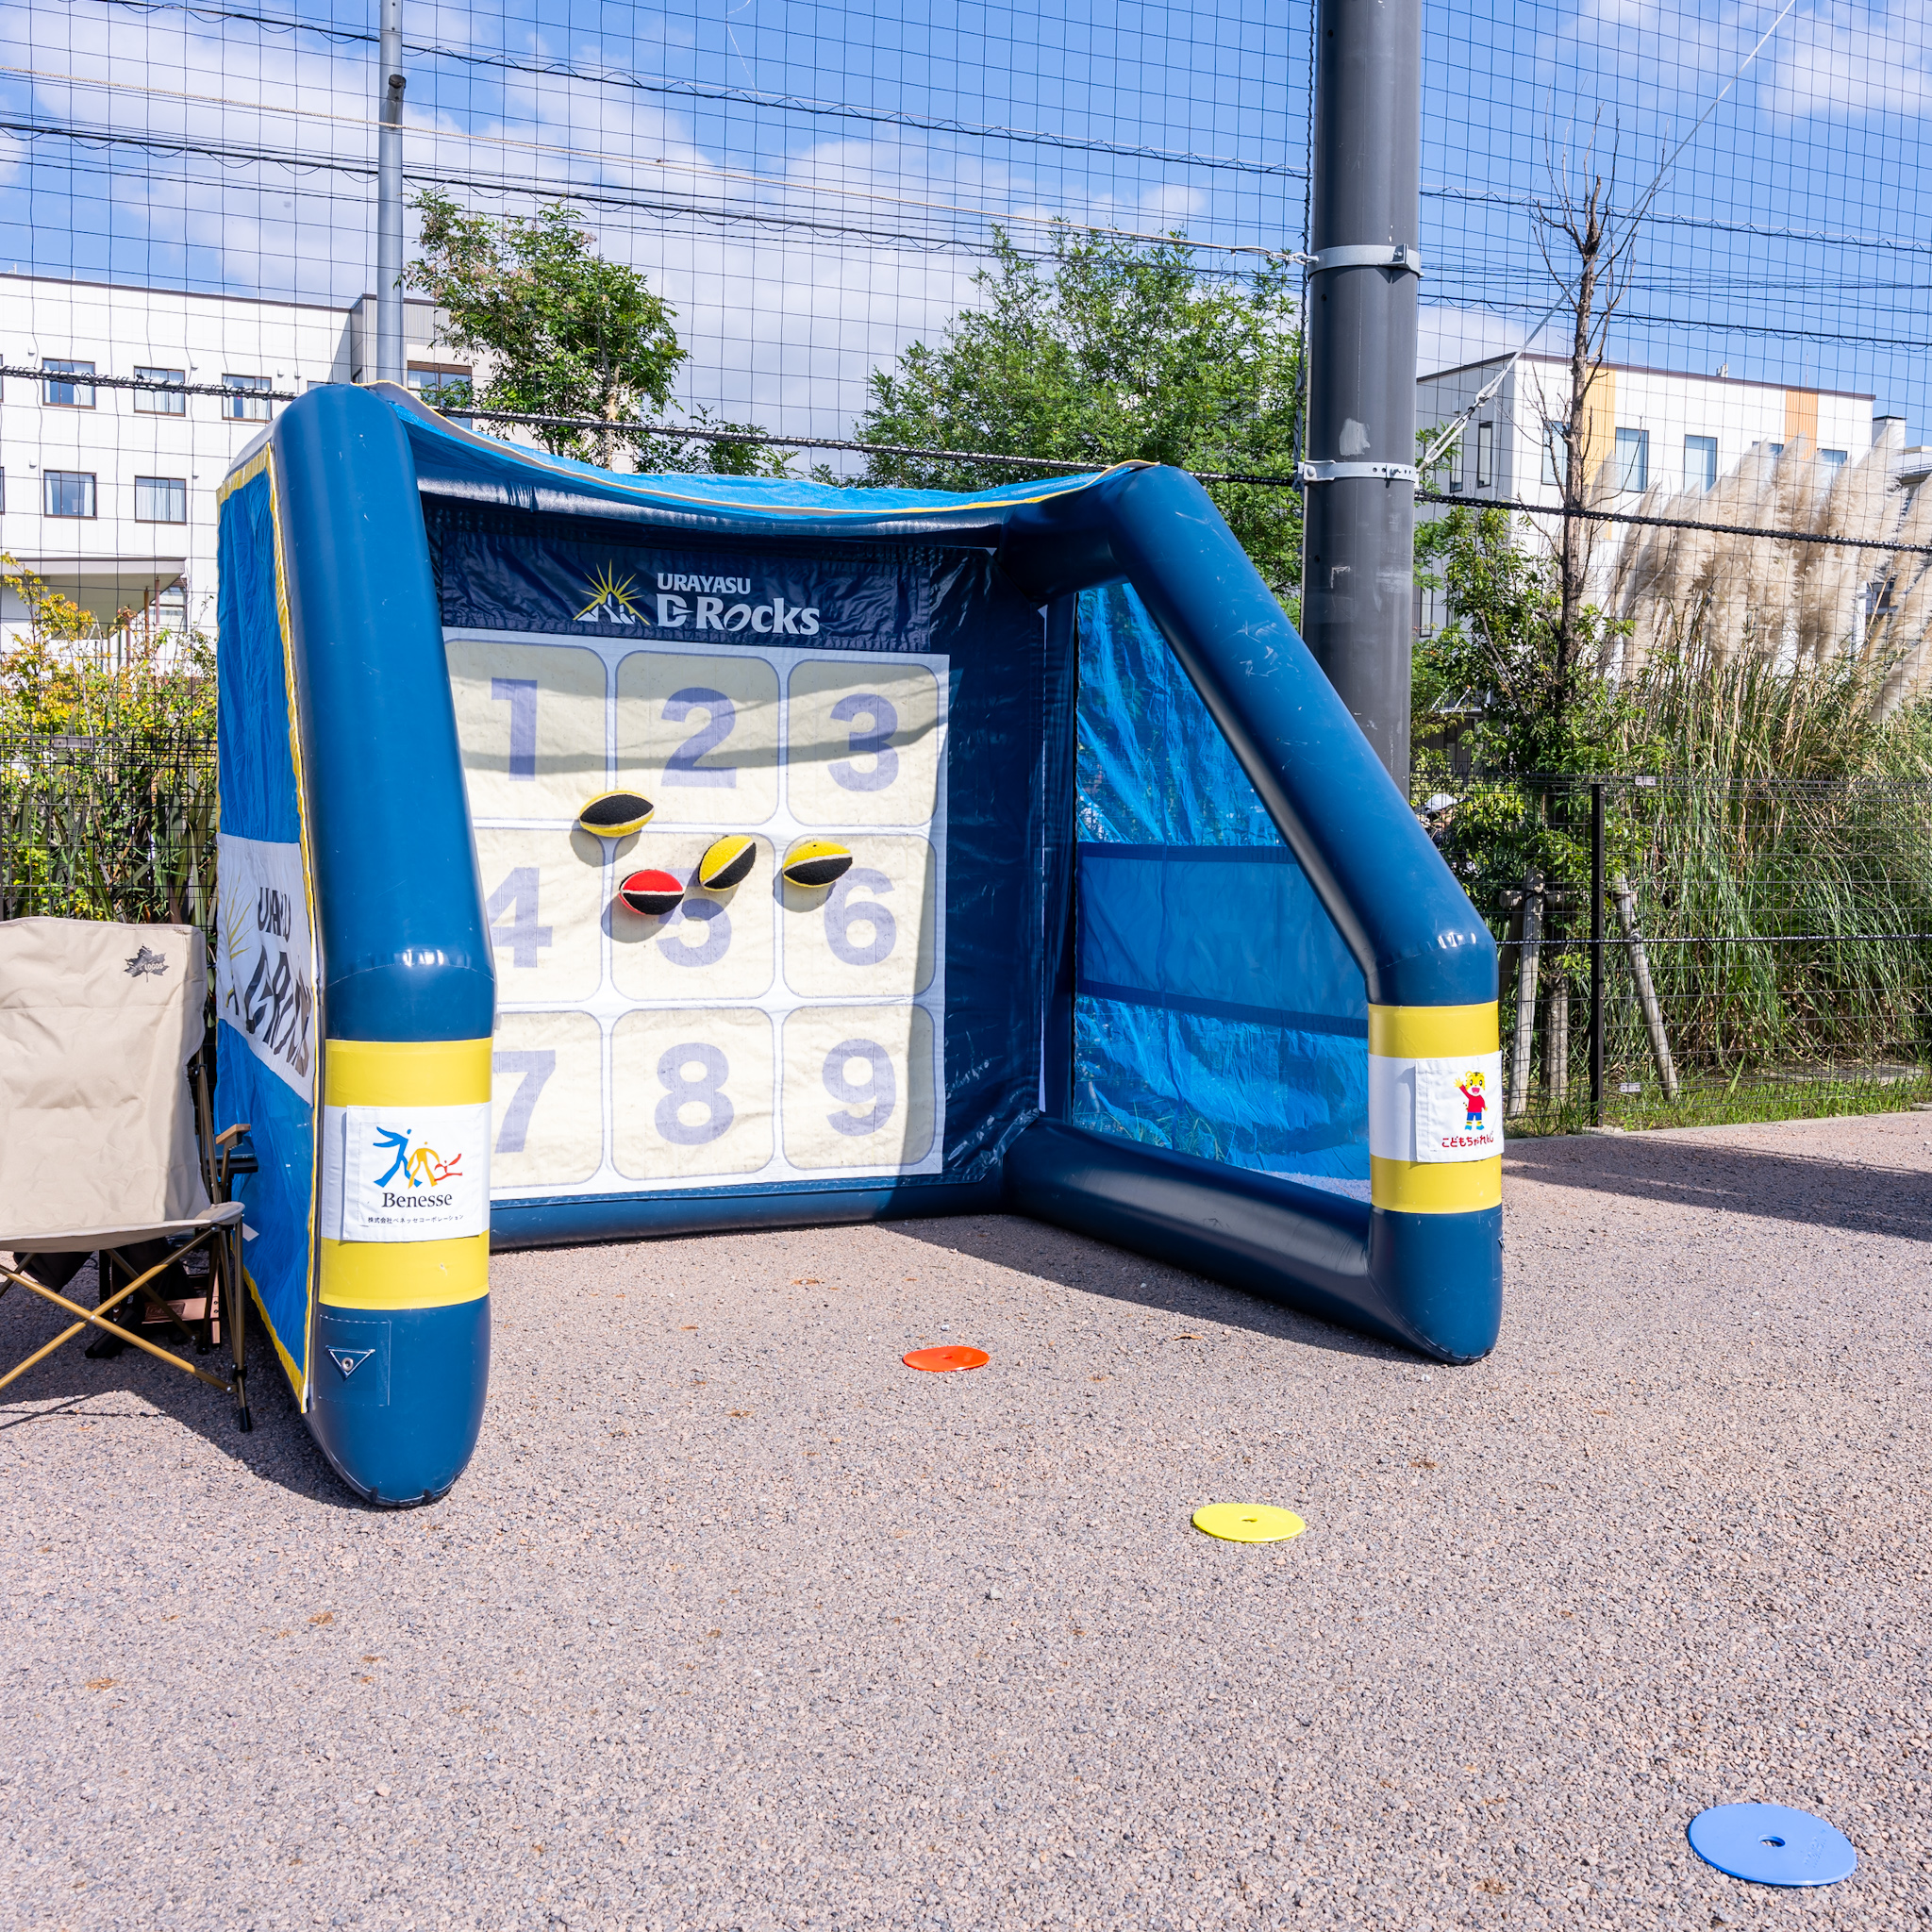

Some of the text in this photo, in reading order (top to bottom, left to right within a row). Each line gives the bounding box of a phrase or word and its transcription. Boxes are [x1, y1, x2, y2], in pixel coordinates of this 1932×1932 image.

[658, 573, 751, 595] URAYASU
[657, 593, 820, 636] D Rocks
[491, 677, 899, 791] 1 2 3
[486, 867, 897, 968] 4 5 6
[144, 962, 163, 971] LOGOS
[491, 1039, 897, 1154] 7 8 9
[381, 1191, 452, 1208] Benesse
